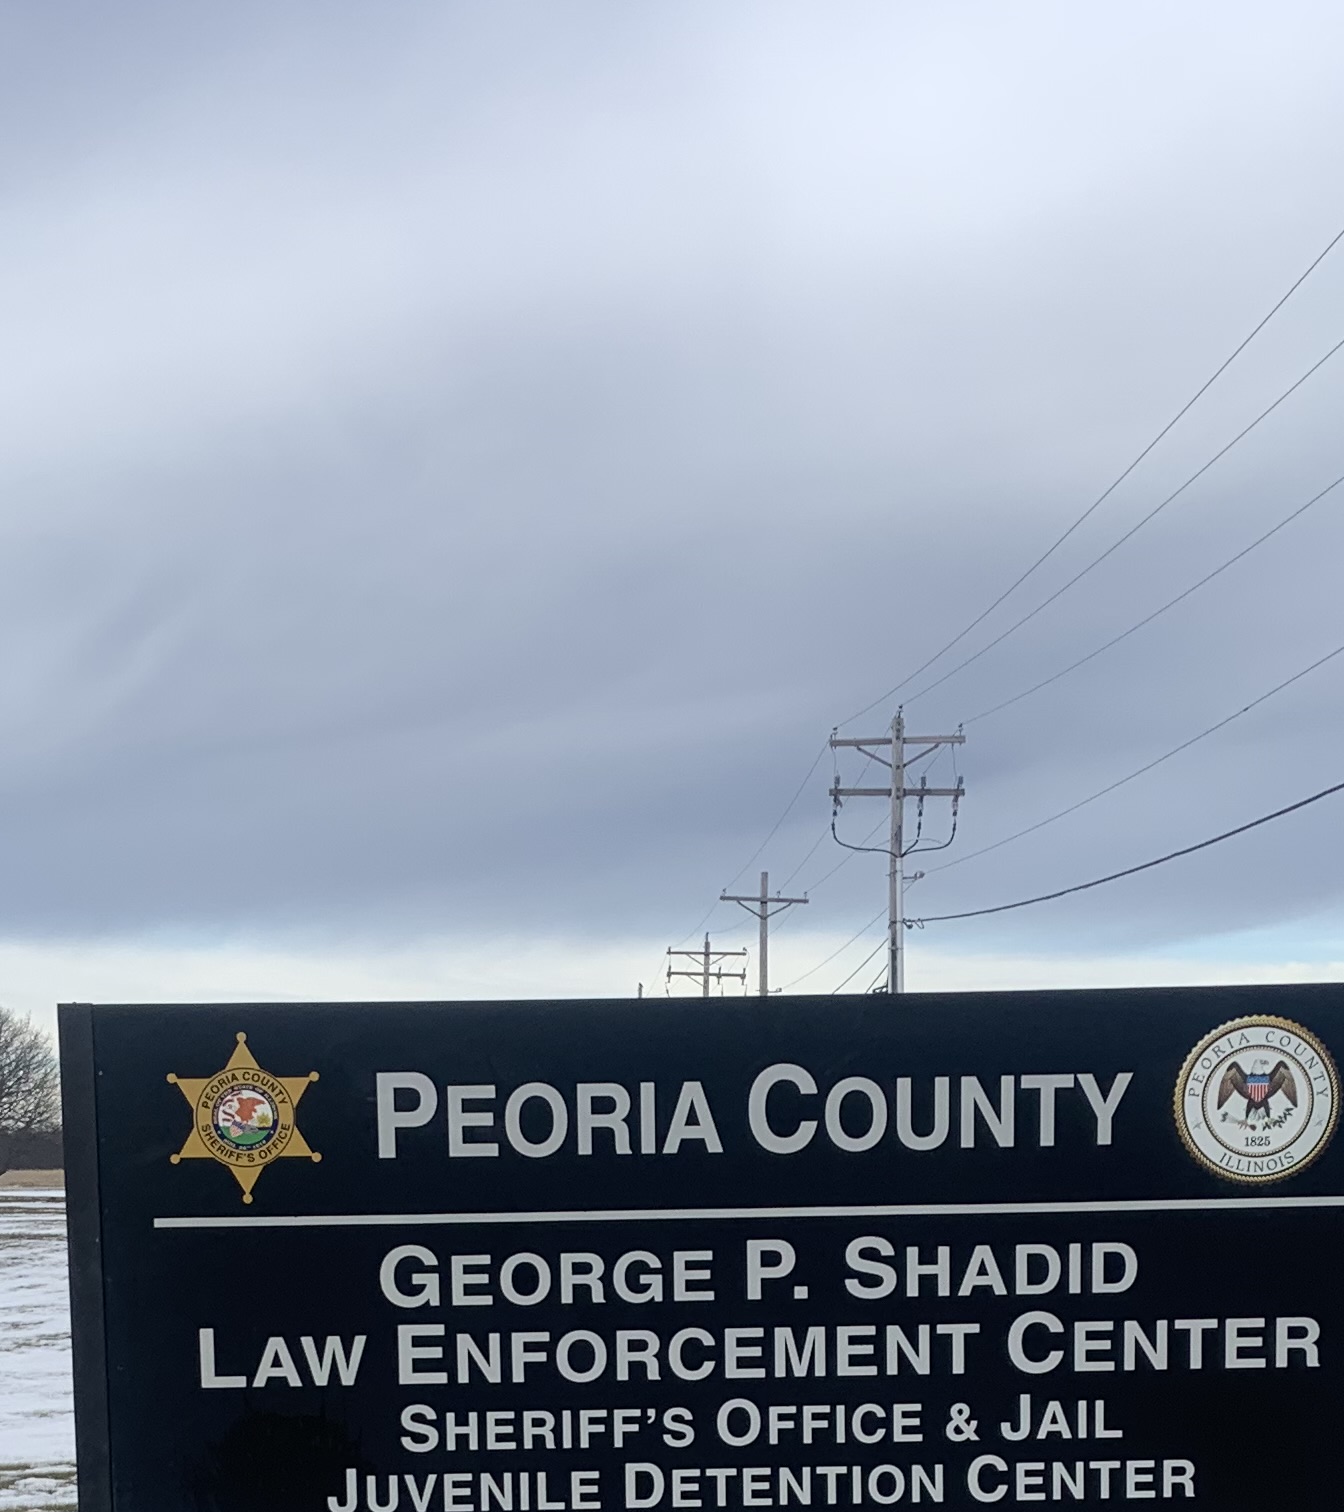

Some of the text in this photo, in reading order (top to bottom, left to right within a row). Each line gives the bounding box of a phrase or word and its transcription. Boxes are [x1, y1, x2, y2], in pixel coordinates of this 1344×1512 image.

[201, 1072, 240, 1110] PEORIA
[242, 1071, 288, 1105] COUNTY
[1188, 1030, 1329, 1099] PEORIA COUNTY
[376, 1071, 724, 1159] PEORIA
[748, 1063, 1134, 1154] COUNTY
[201, 1122, 290, 1163] SHERIFF'S OFFICE
[1219, 1151, 1295, 1173] ILLINOIS
[1244, 1136, 1271, 1147] 1825
[379, 1235, 1138, 1309] GEORGE P. SHADID
[199, 1310, 1321, 1389] LAW ENFORCEMENT CENTER
[400, 1393, 1123, 1453] SHERIFF'S OFFICE & JAIL
[624, 1462, 944, 1509] DETENTION
[967, 1454, 1196, 1503] CENTER
